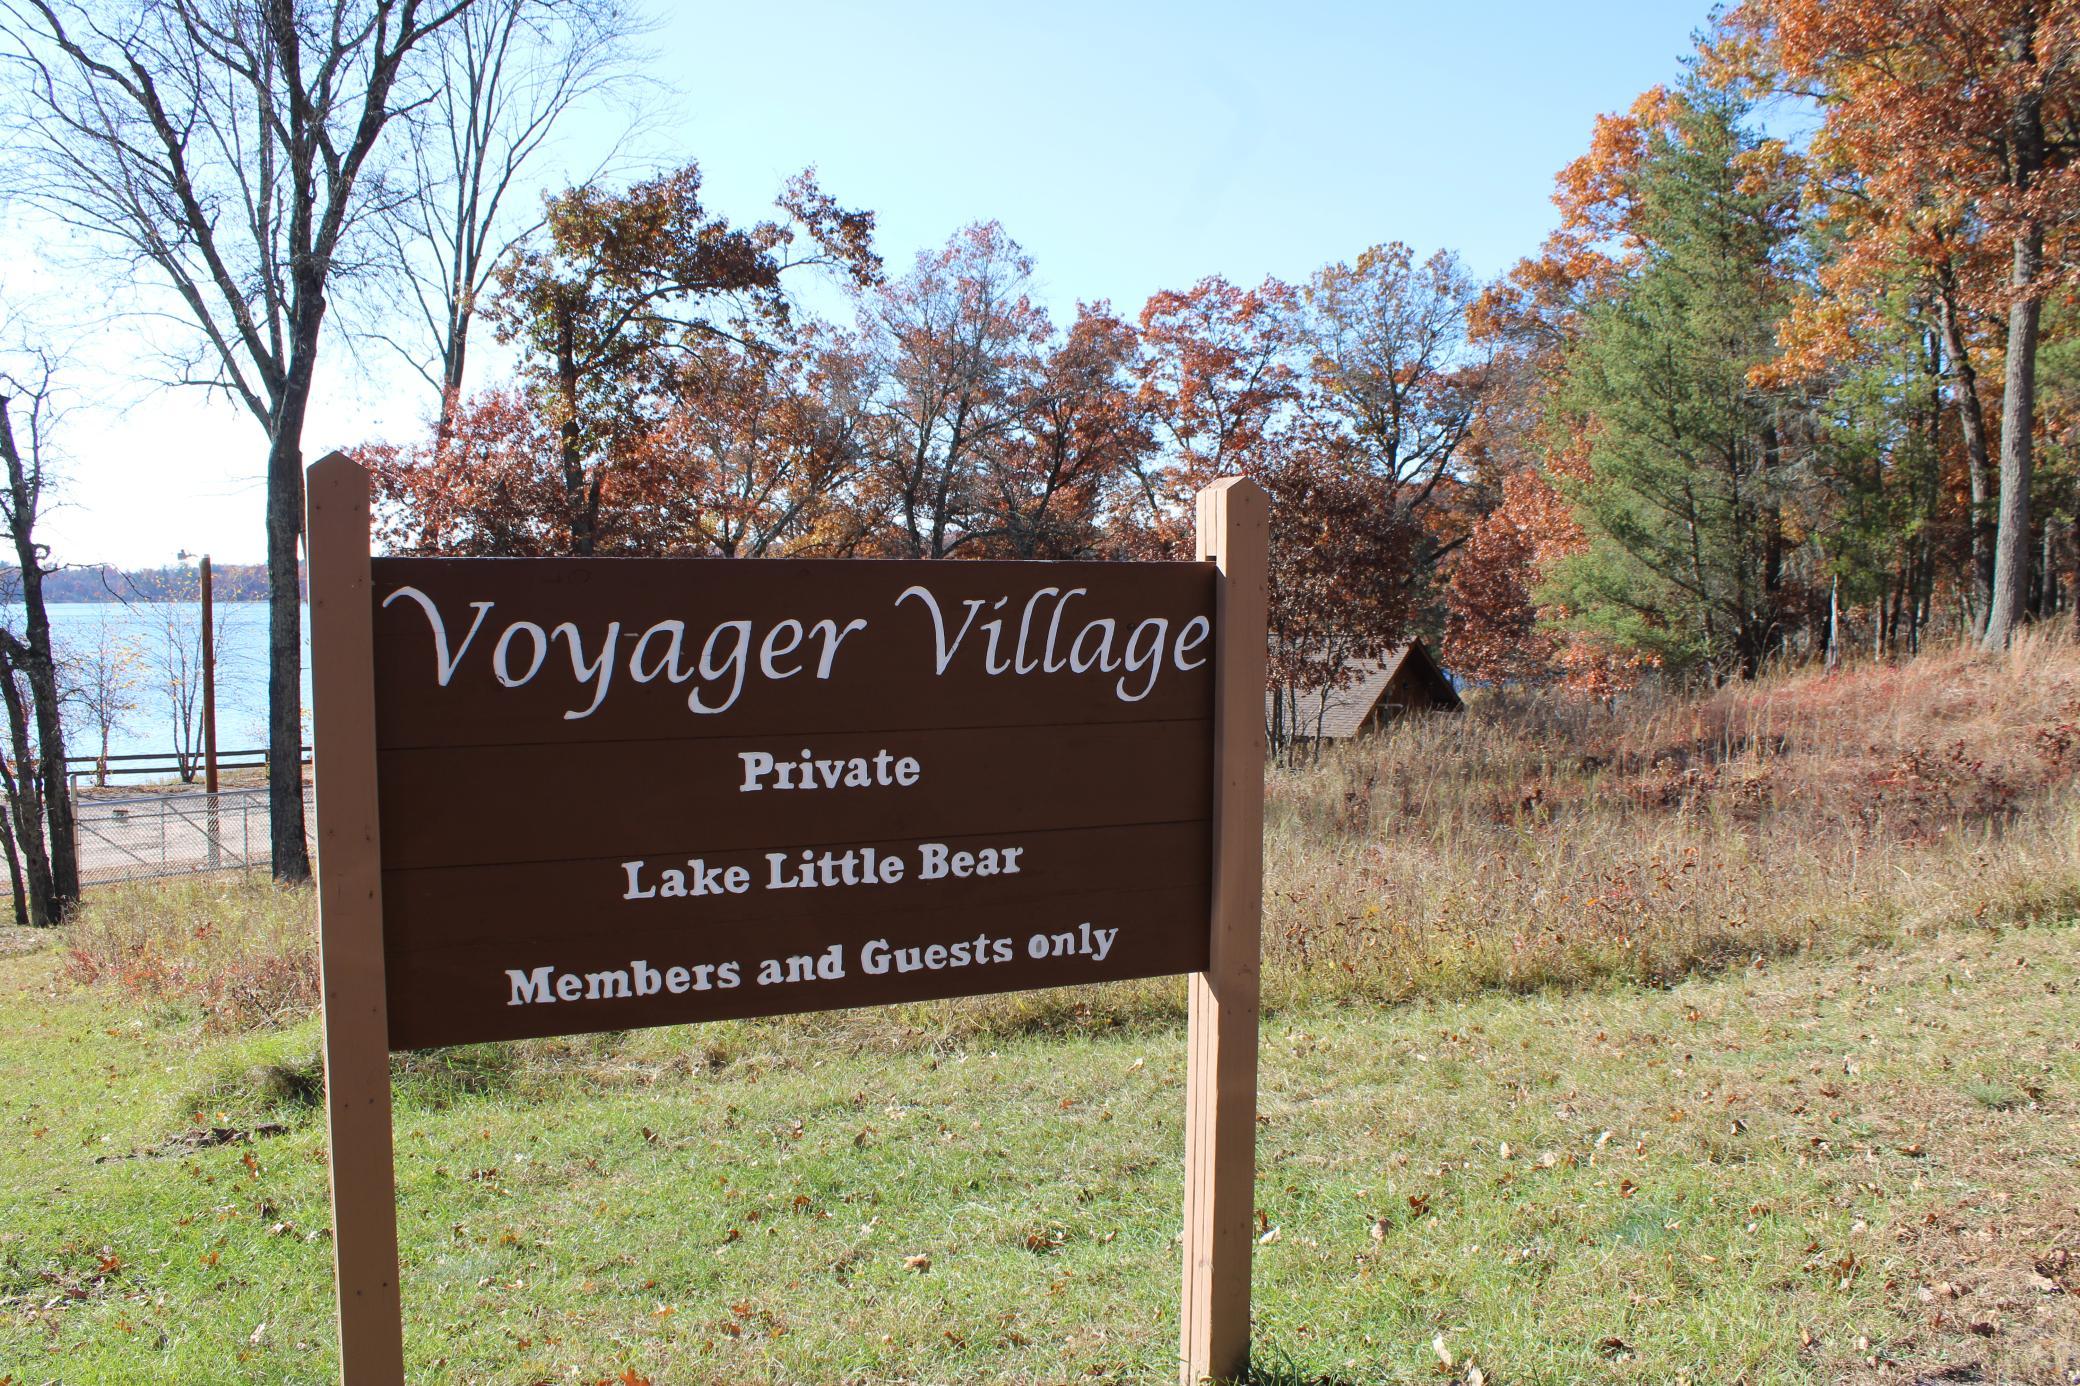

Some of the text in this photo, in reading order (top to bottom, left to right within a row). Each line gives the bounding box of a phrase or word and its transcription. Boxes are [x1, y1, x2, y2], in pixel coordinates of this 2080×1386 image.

[382, 585, 1210, 720] Voyager Village
[737, 748, 921, 792] Private
[621, 844, 1024, 900] Lake Little Bear
[505, 922, 1119, 1006] Members and Guests only
